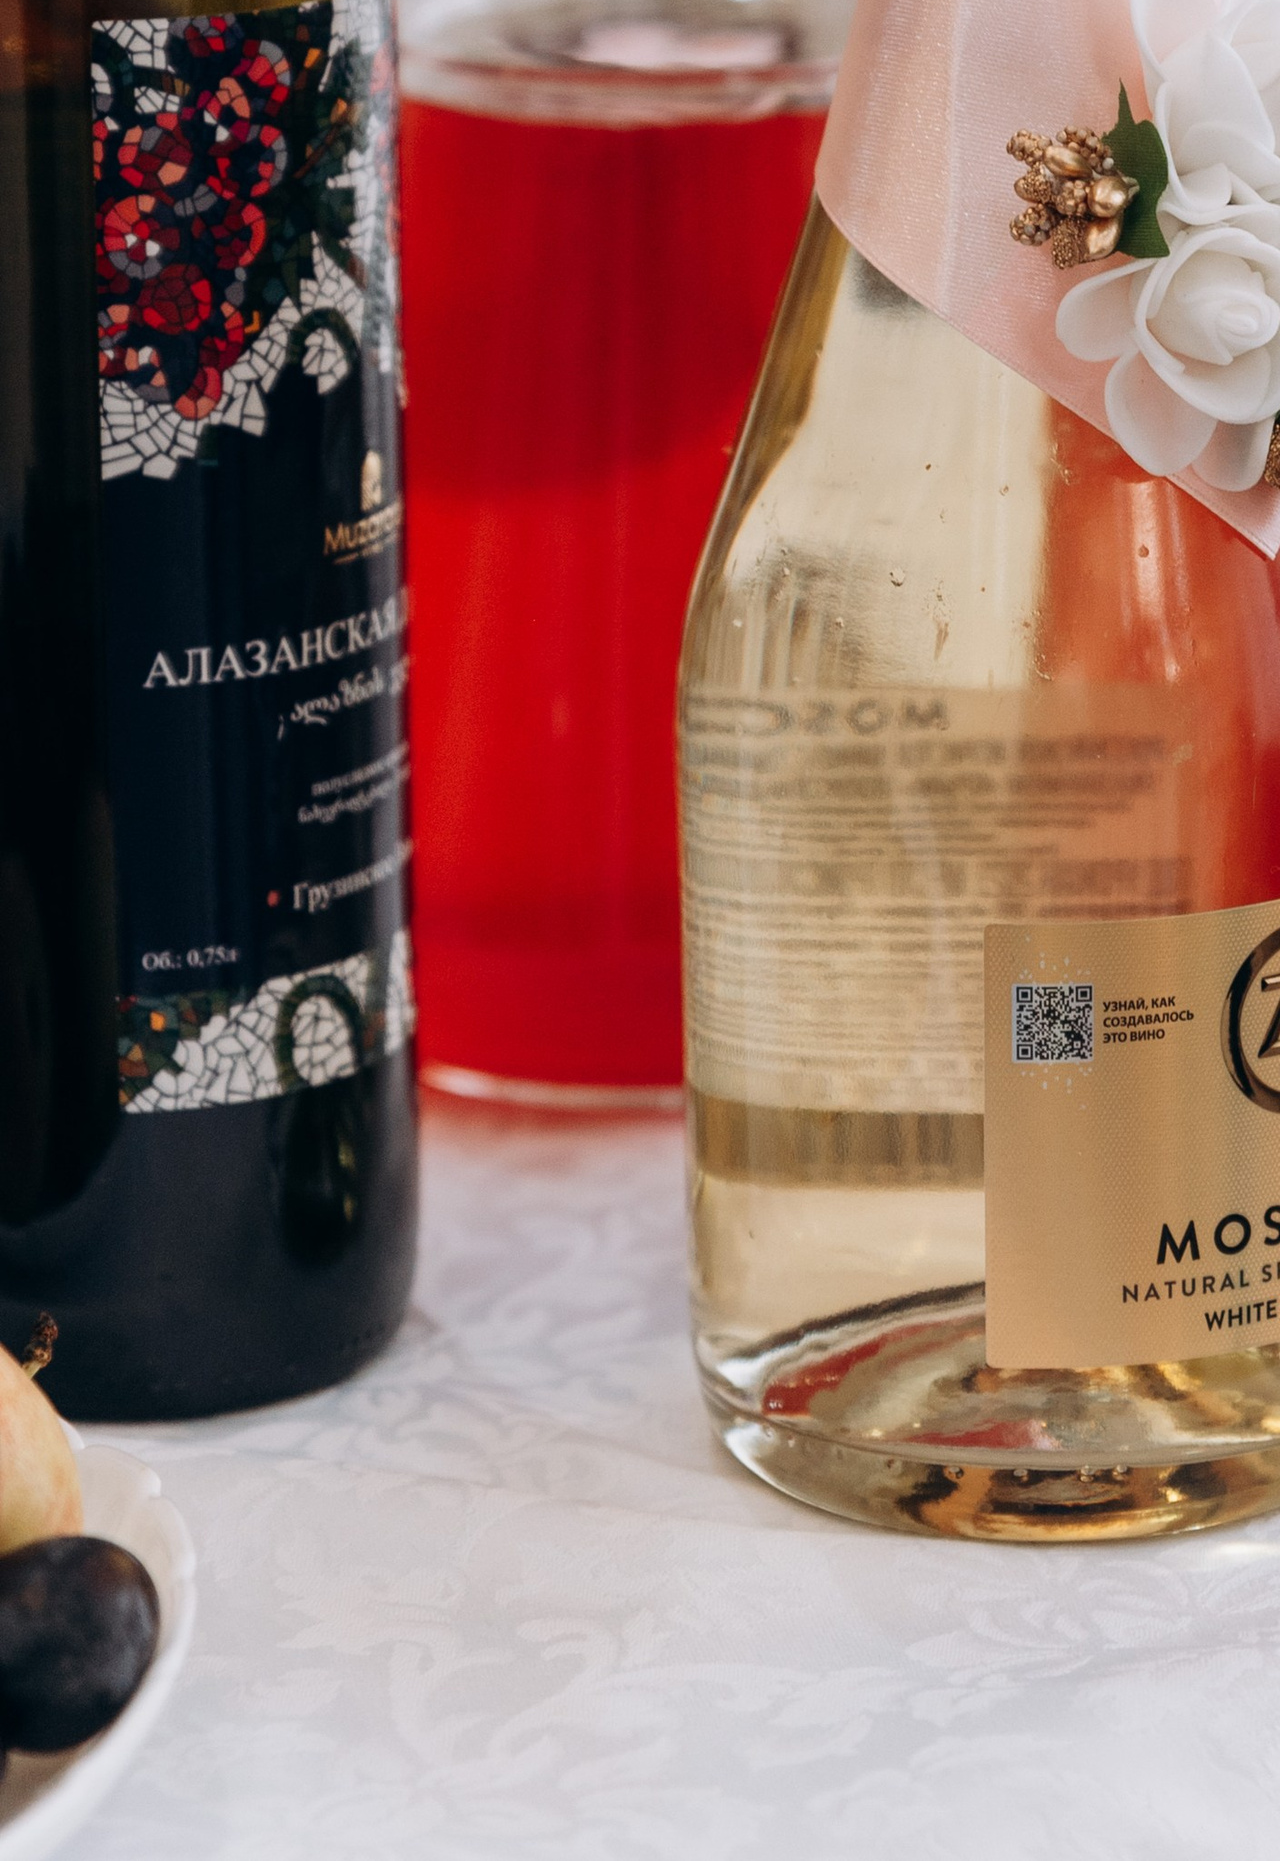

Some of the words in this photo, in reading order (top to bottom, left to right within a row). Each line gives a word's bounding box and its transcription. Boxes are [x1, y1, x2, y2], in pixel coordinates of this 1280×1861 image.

[1102, 998, 1149, 1013] УЗНАЙ,
[1151, 996, 1176, 1009] КАК
[1102, 1009, 1195, 1029] СОЗДАВАЛОСЬ
[1102, 1031, 1127, 1044] ЭТО
[1130, 1028, 1166, 1042] ВИНО
[1122, 1269, 1250, 1304] NATURAL
[1204, 1299, 1278, 1331] WHITE
